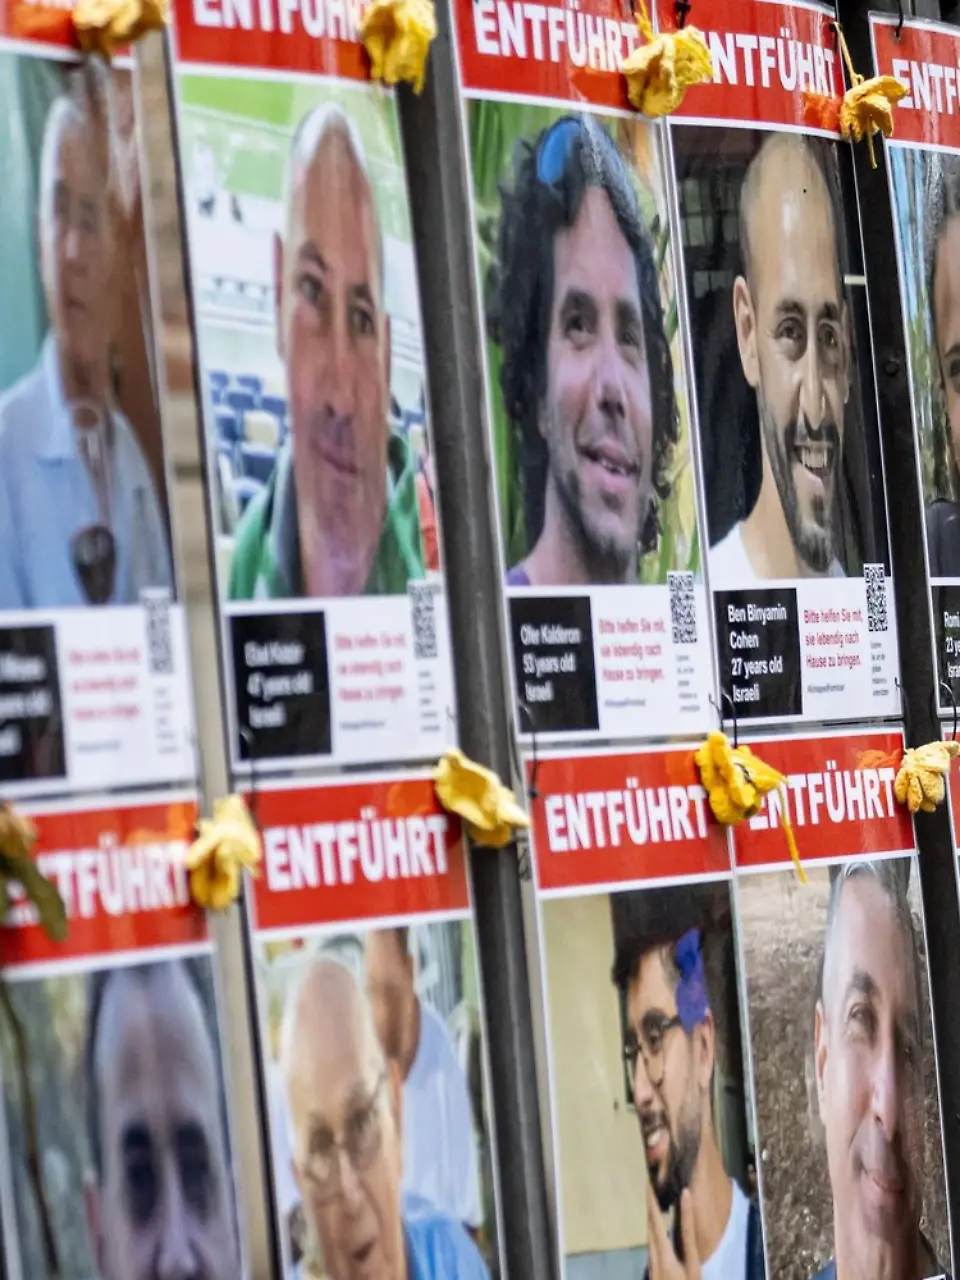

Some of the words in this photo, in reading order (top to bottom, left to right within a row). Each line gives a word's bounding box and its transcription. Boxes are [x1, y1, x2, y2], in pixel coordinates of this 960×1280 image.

[473, 0, 639, 72] ENTFÜHRT
[704, 29, 835, 99] NTFÜHRT
[728, 605, 747, 622] Ben
[747, 603, 788, 625] Binyamin
[730, 631, 760, 649] Cohen
[731, 658, 743, 675] 27
[744, 660, 770, 679] years
[769, 656, 784, 673] old
[733, 683, 760, 702] Israeli
[545, 777, 708, 852] ENTFÜHRT
[264, 806, 448, 893] ENTFÜHRT
